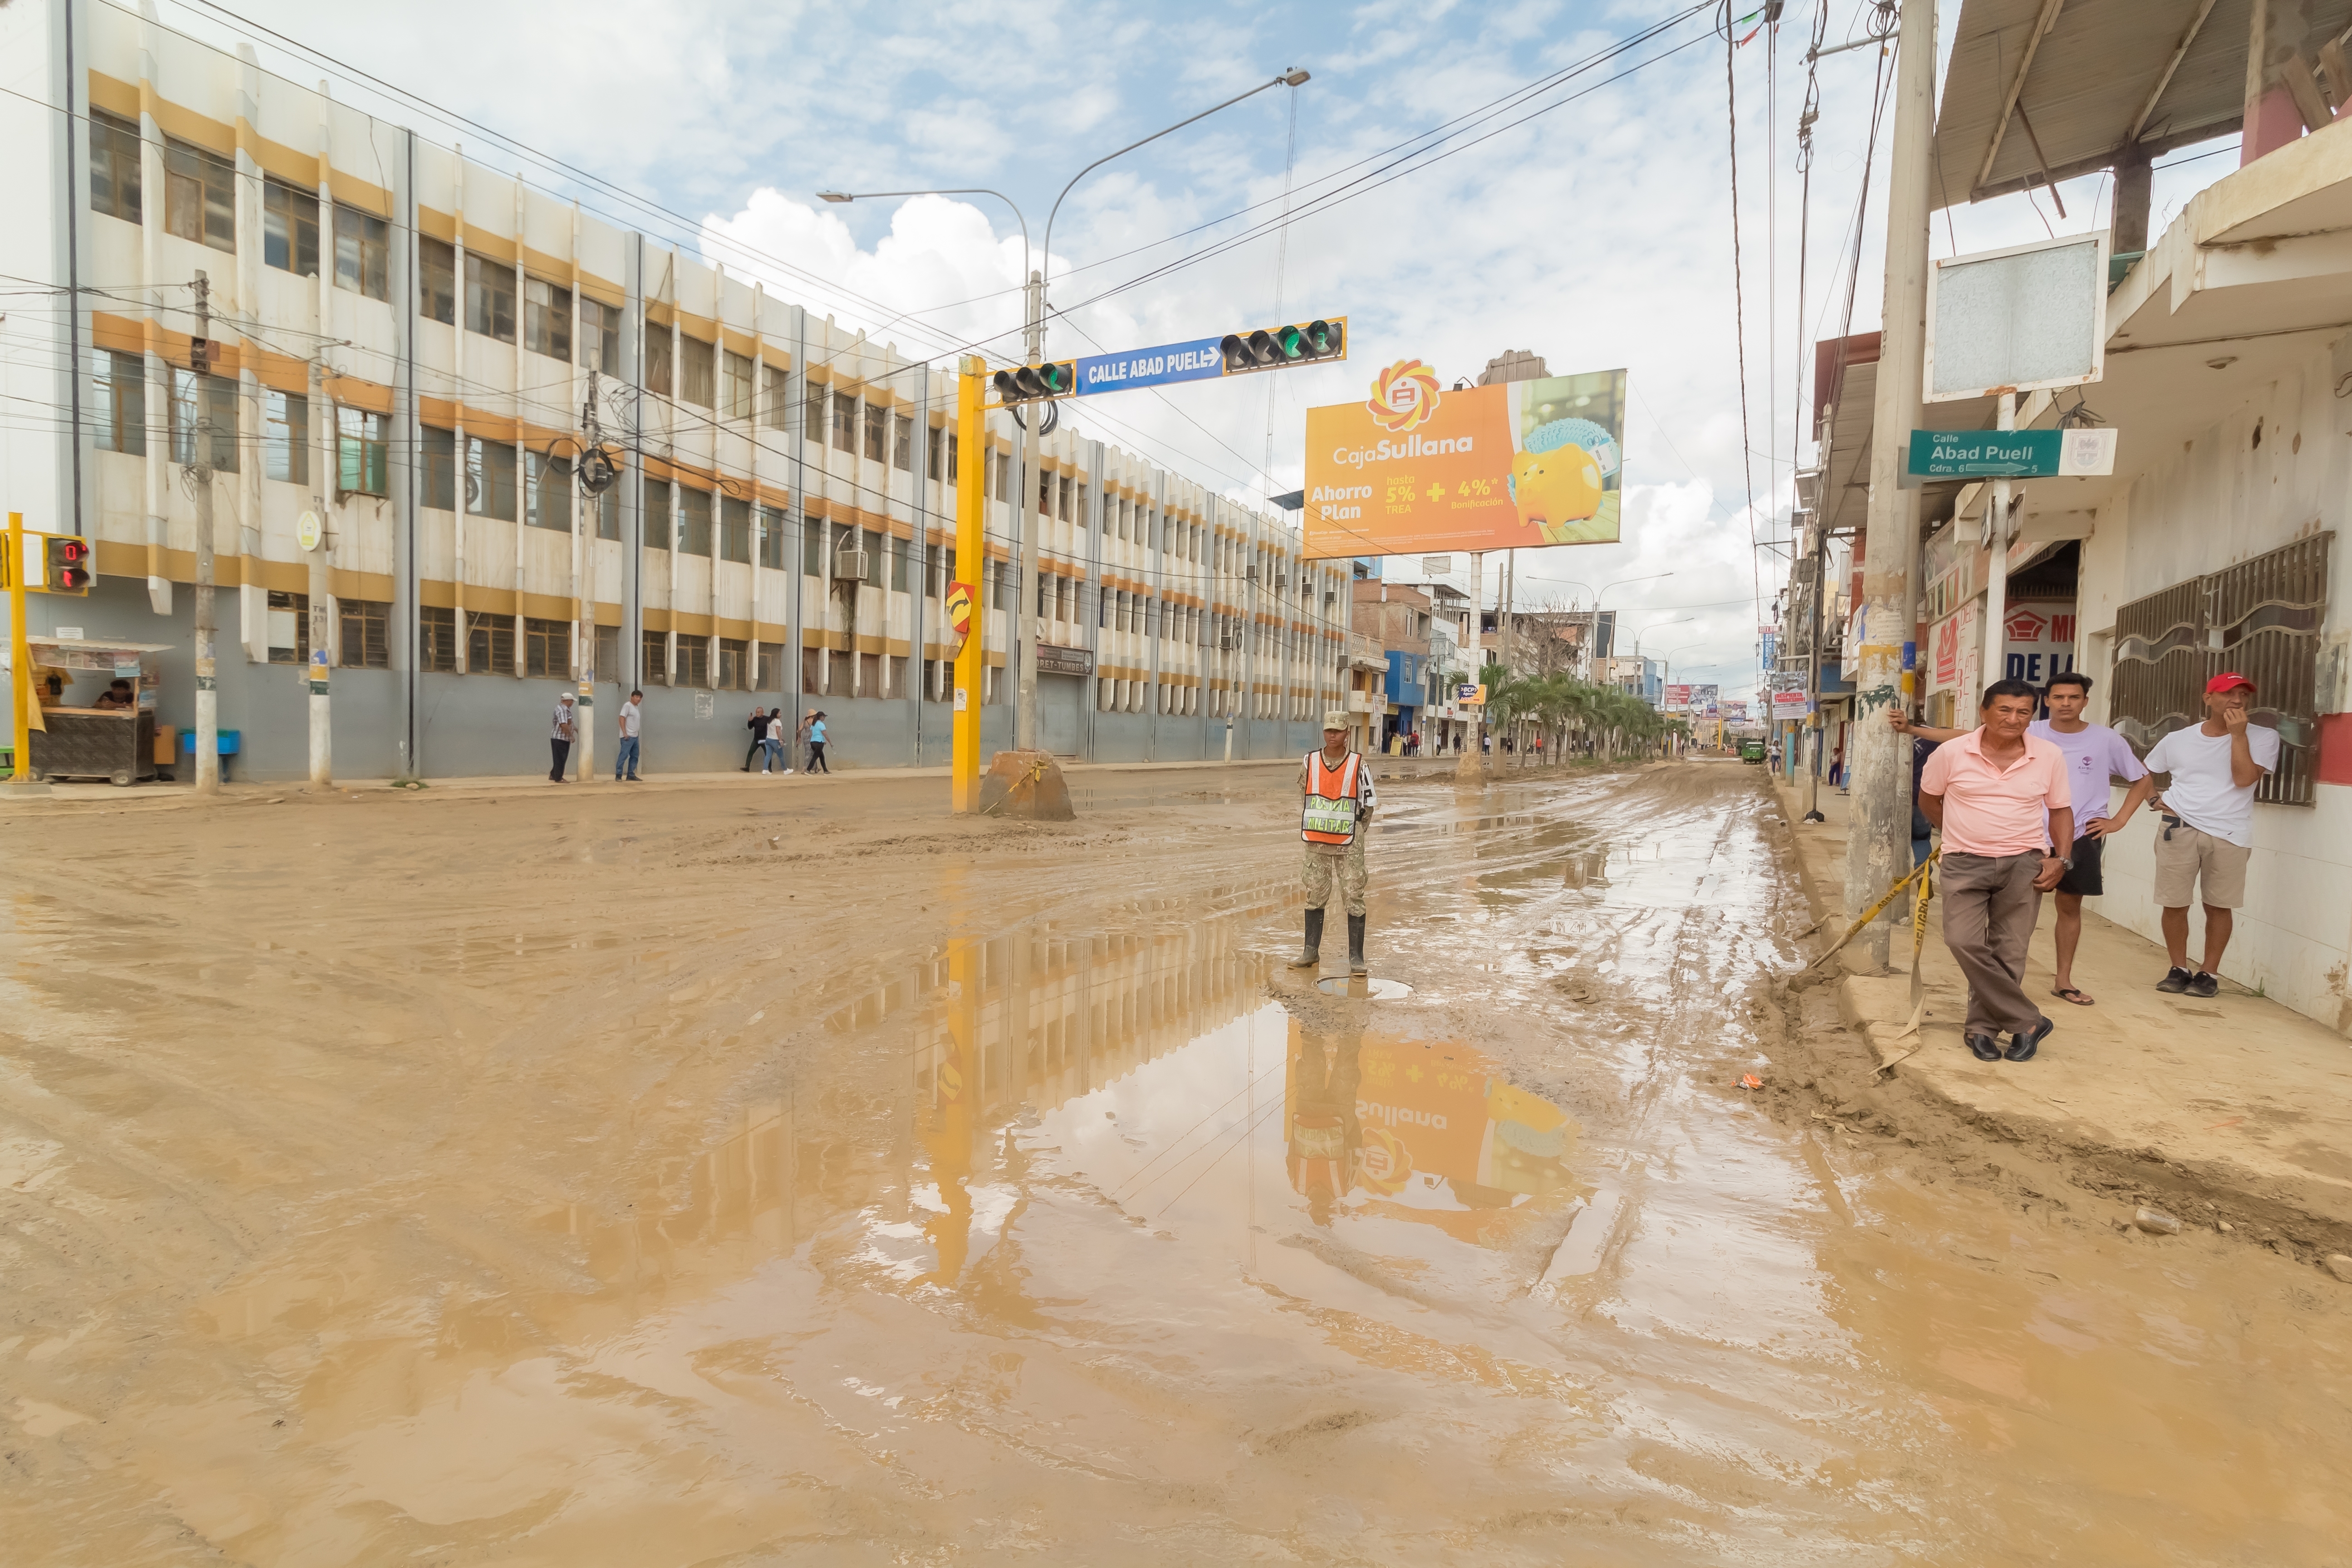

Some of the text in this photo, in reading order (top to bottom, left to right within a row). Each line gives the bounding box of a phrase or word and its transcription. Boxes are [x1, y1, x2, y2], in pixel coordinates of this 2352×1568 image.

[1089, 350, 1208, 384] CALLE ABAD PUELL
[1933, 434, 1959, 443] Calle
[1333, 434, 1473, 470] CajaSullana
[1931, 446, 2033, 460] Abad Puell
[1929, 464, 2038, 473] Cdra. 6 5
[1387, 475, 1415, 485] hasta
[1312, 485, 1372, 503] Ahorro
[1386, 485, 1416, 504] 5%
[1386, 504, 1412, 514] TREA
[1451, 497, 1503, 510] Bonificación
[1321, 503, 1361, 521] Plan
[2006, 653, 2042, 682] DE
[1310, 797, 1350, 812] POLICIA
[1308, 817, 1350, 832] MILITAR
